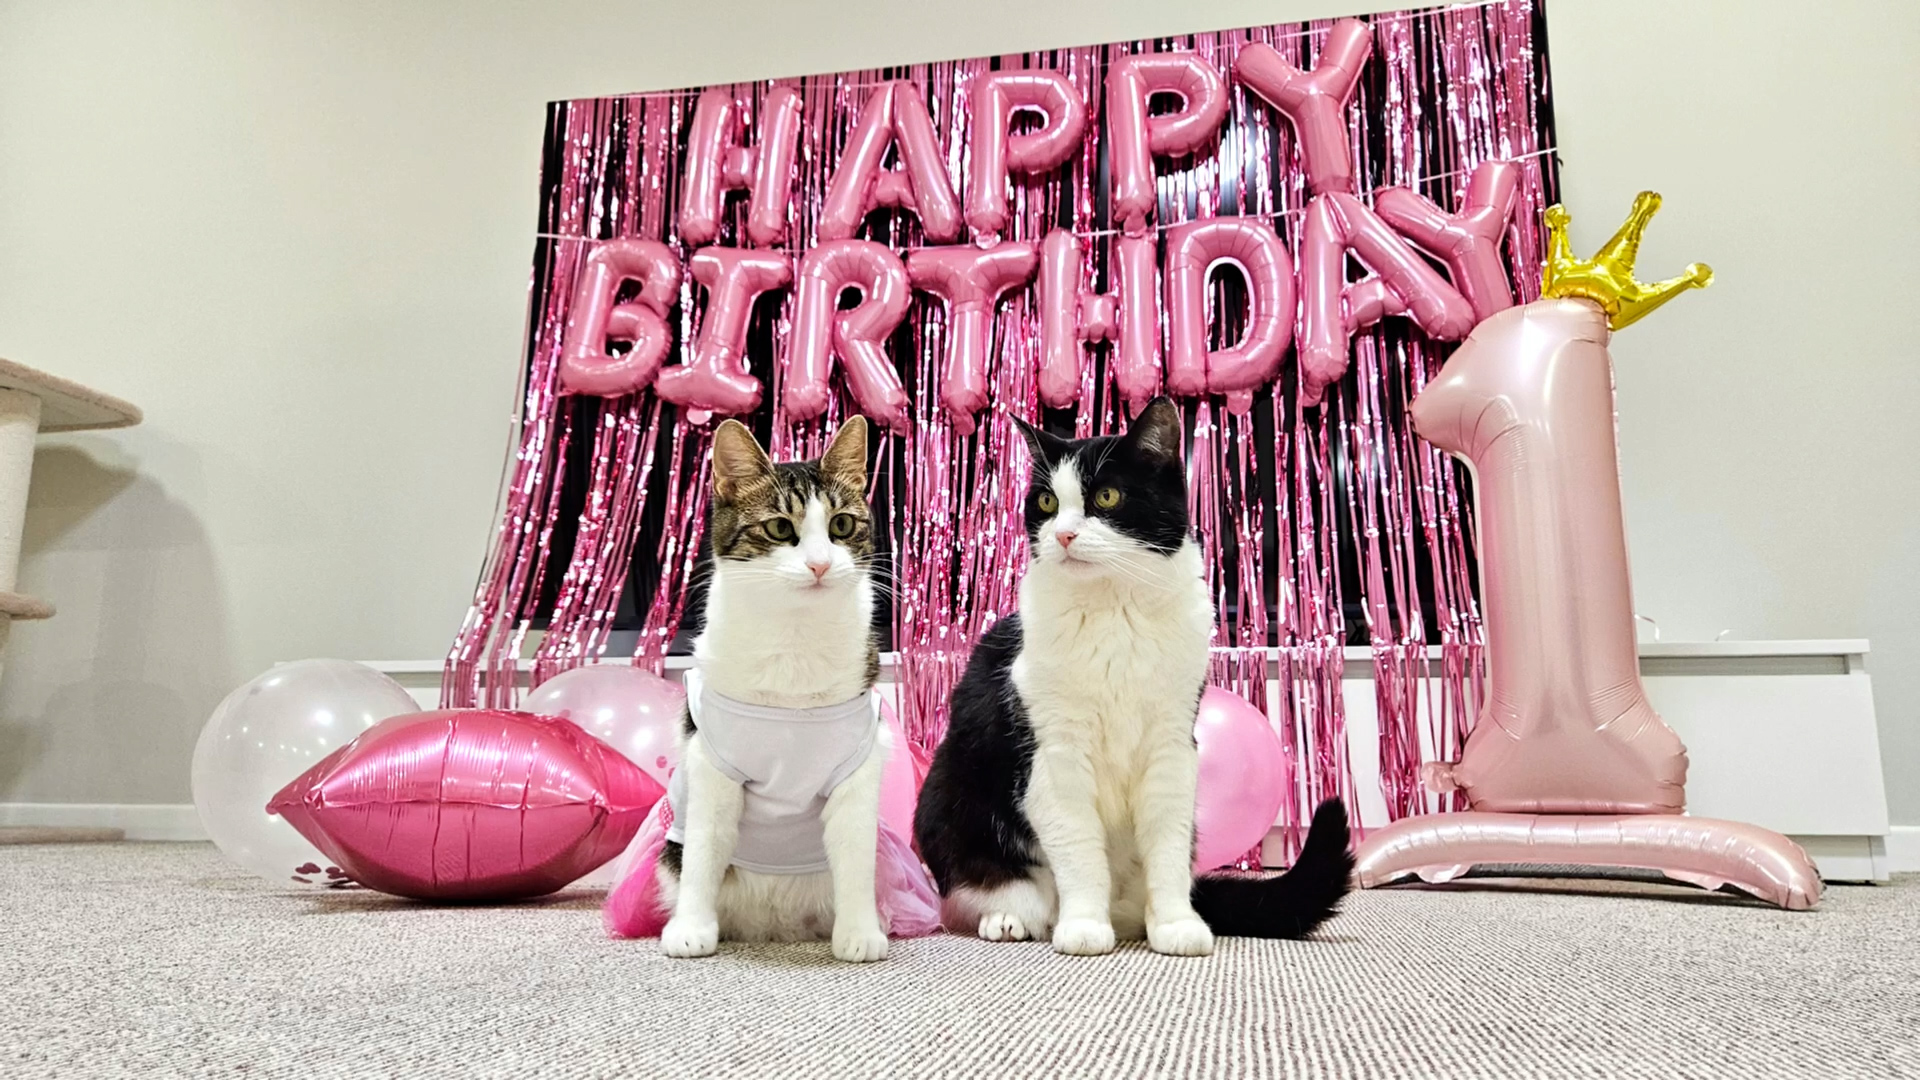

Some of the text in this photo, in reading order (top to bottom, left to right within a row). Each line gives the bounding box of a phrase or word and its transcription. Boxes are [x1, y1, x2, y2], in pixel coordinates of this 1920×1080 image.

[679, 18, 1373, 246] HAPPY
[557, 160, 1517, 430] BIRTHDAY
[1411, 297, 1690, 816] 1
